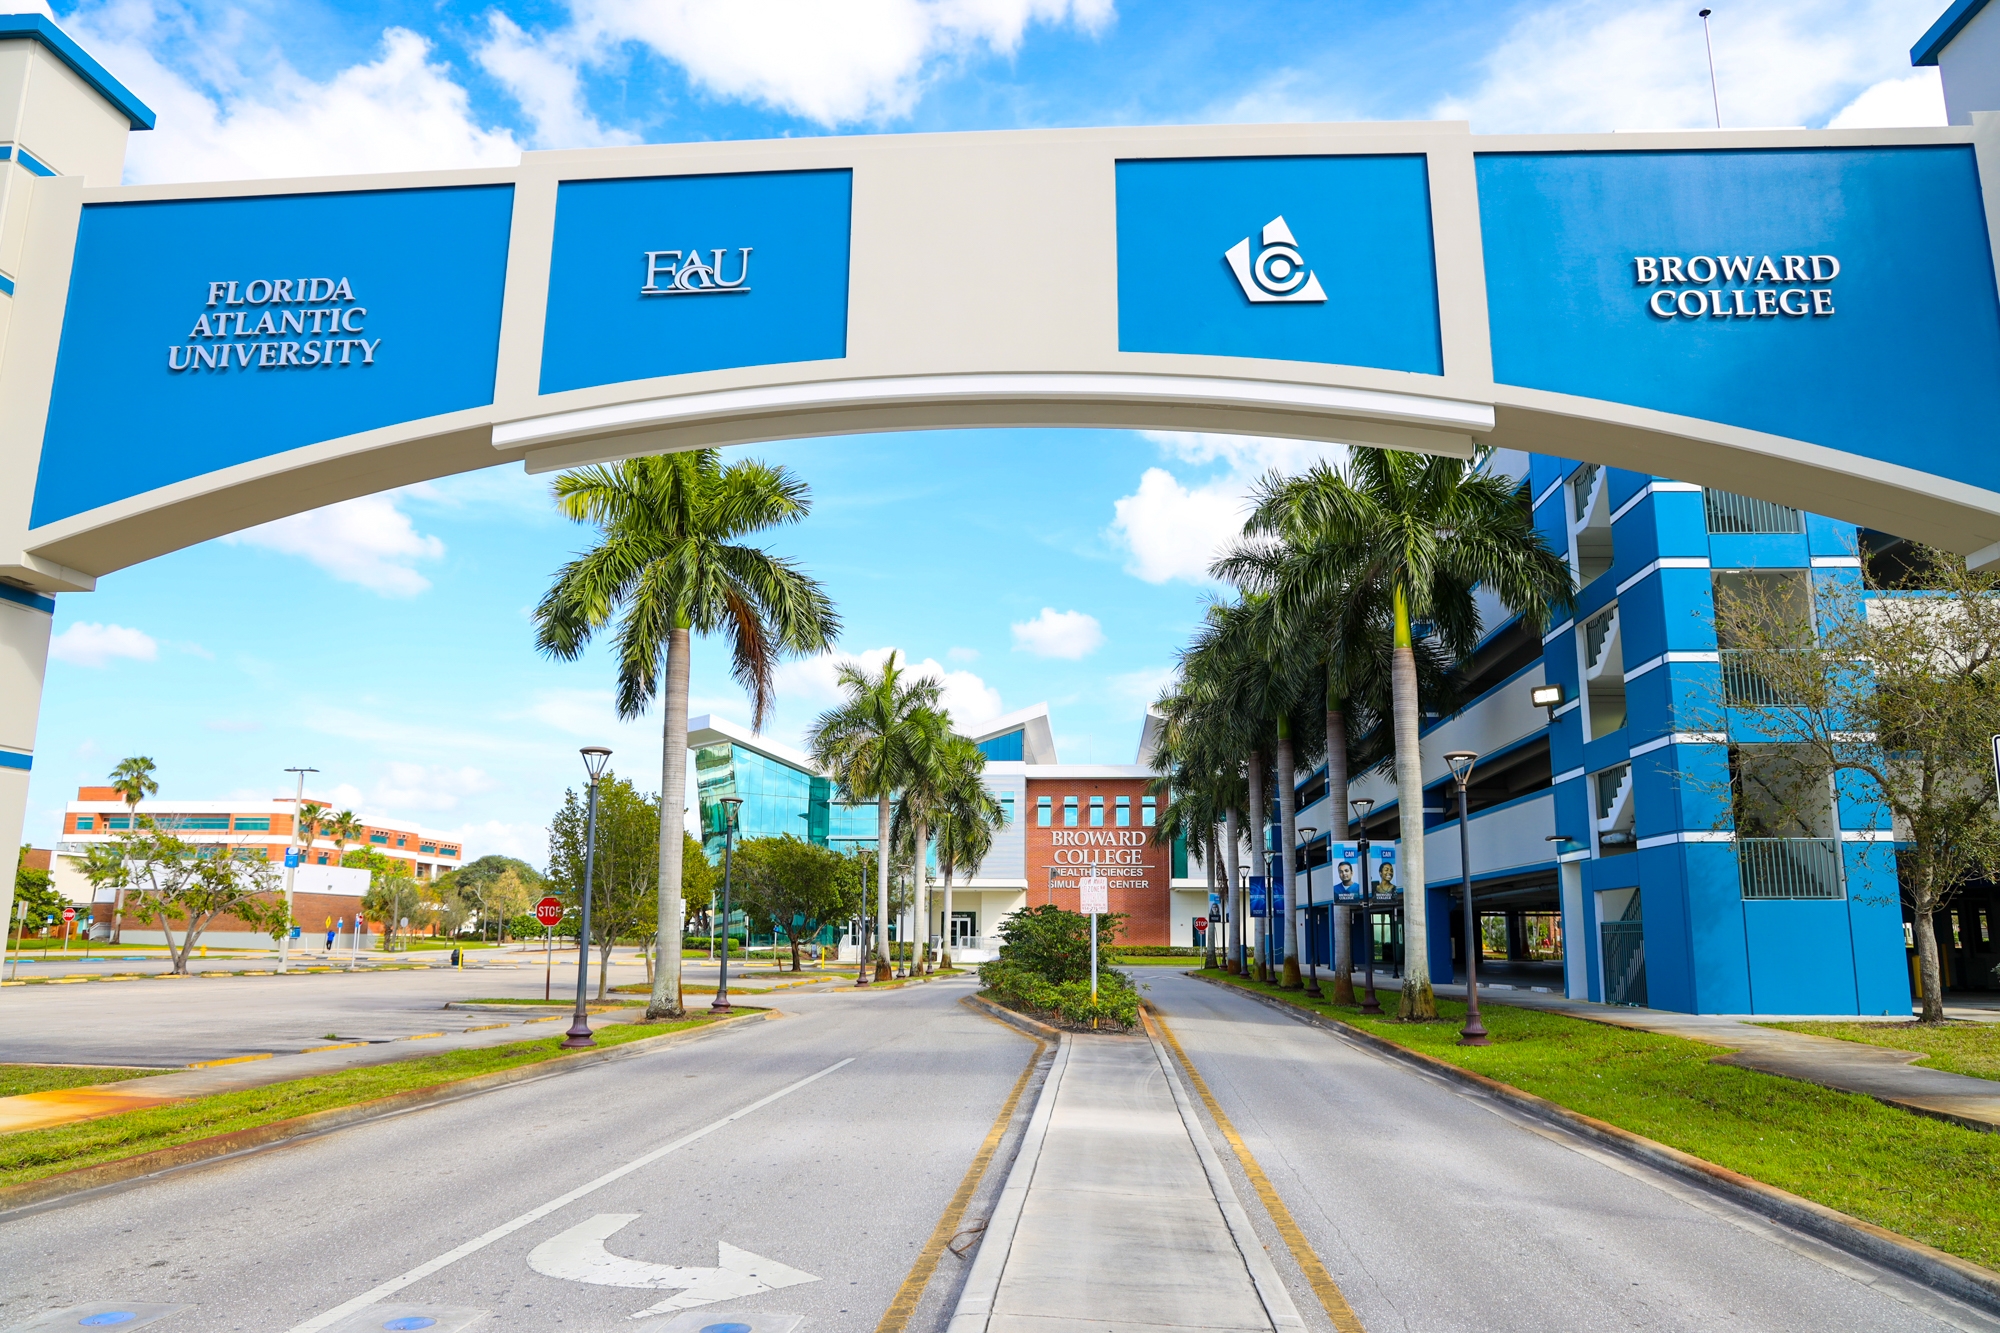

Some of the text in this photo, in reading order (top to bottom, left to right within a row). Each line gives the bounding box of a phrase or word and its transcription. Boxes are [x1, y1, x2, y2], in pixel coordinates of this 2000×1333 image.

[641, 247, 754, 291] FAU
[1633, 254, 1841, 283] BROWARD
[205, 276, 356, 306] FLORIDA
[1649, 288, 1835, 317] COLLEGE
[188, 307, 368, 338] ATLANTIC
[168, 338, 382, 370] UNIVERSITY
[1051, 830, 1147, 847] BROWARD
[1054, 849, 1143, 865] COLLEGE
[1096, 868, 1144, 876] SCIENCES
[1109, 880, 1149, 889] CENTER
